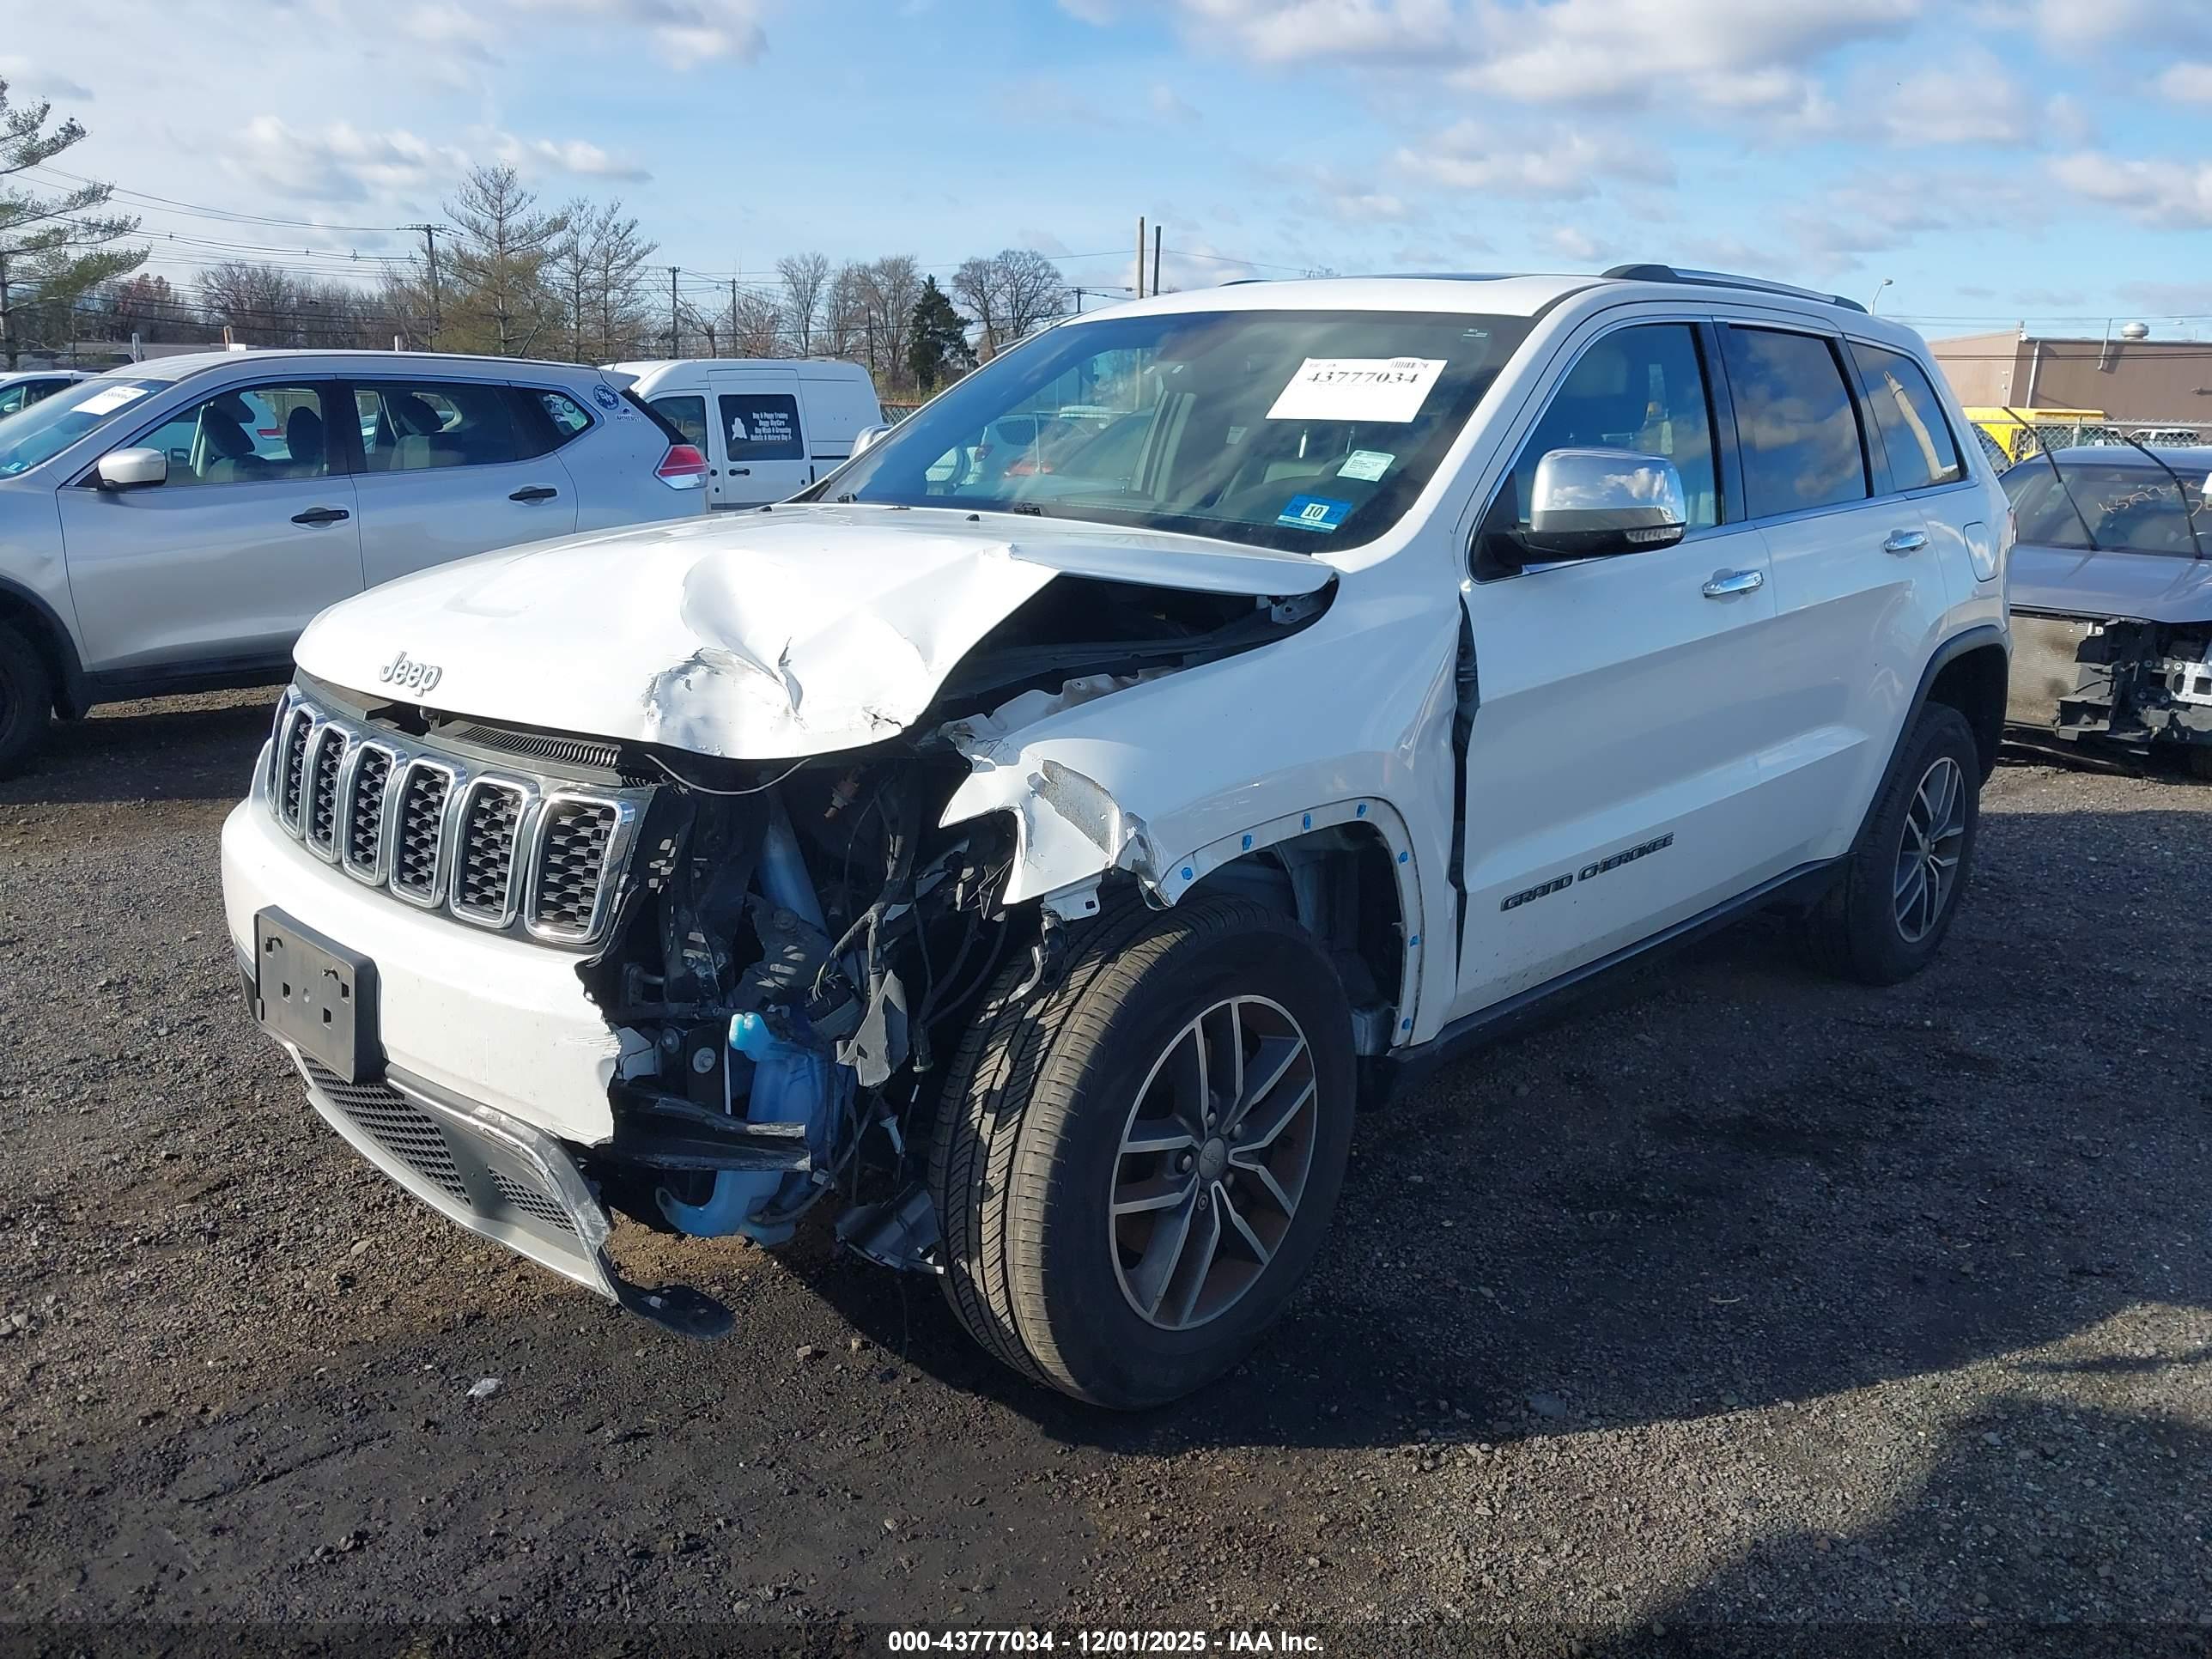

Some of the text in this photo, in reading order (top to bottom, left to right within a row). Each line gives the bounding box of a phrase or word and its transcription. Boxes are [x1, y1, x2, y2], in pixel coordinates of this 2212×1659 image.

[1306, 371, 1419, 384] 43777034
[1304, 505, 1324, 519] 10
[380, 651, 442, 697] Jeep
[1500, 831, 1674, 912] GRAND CHEROKEE
